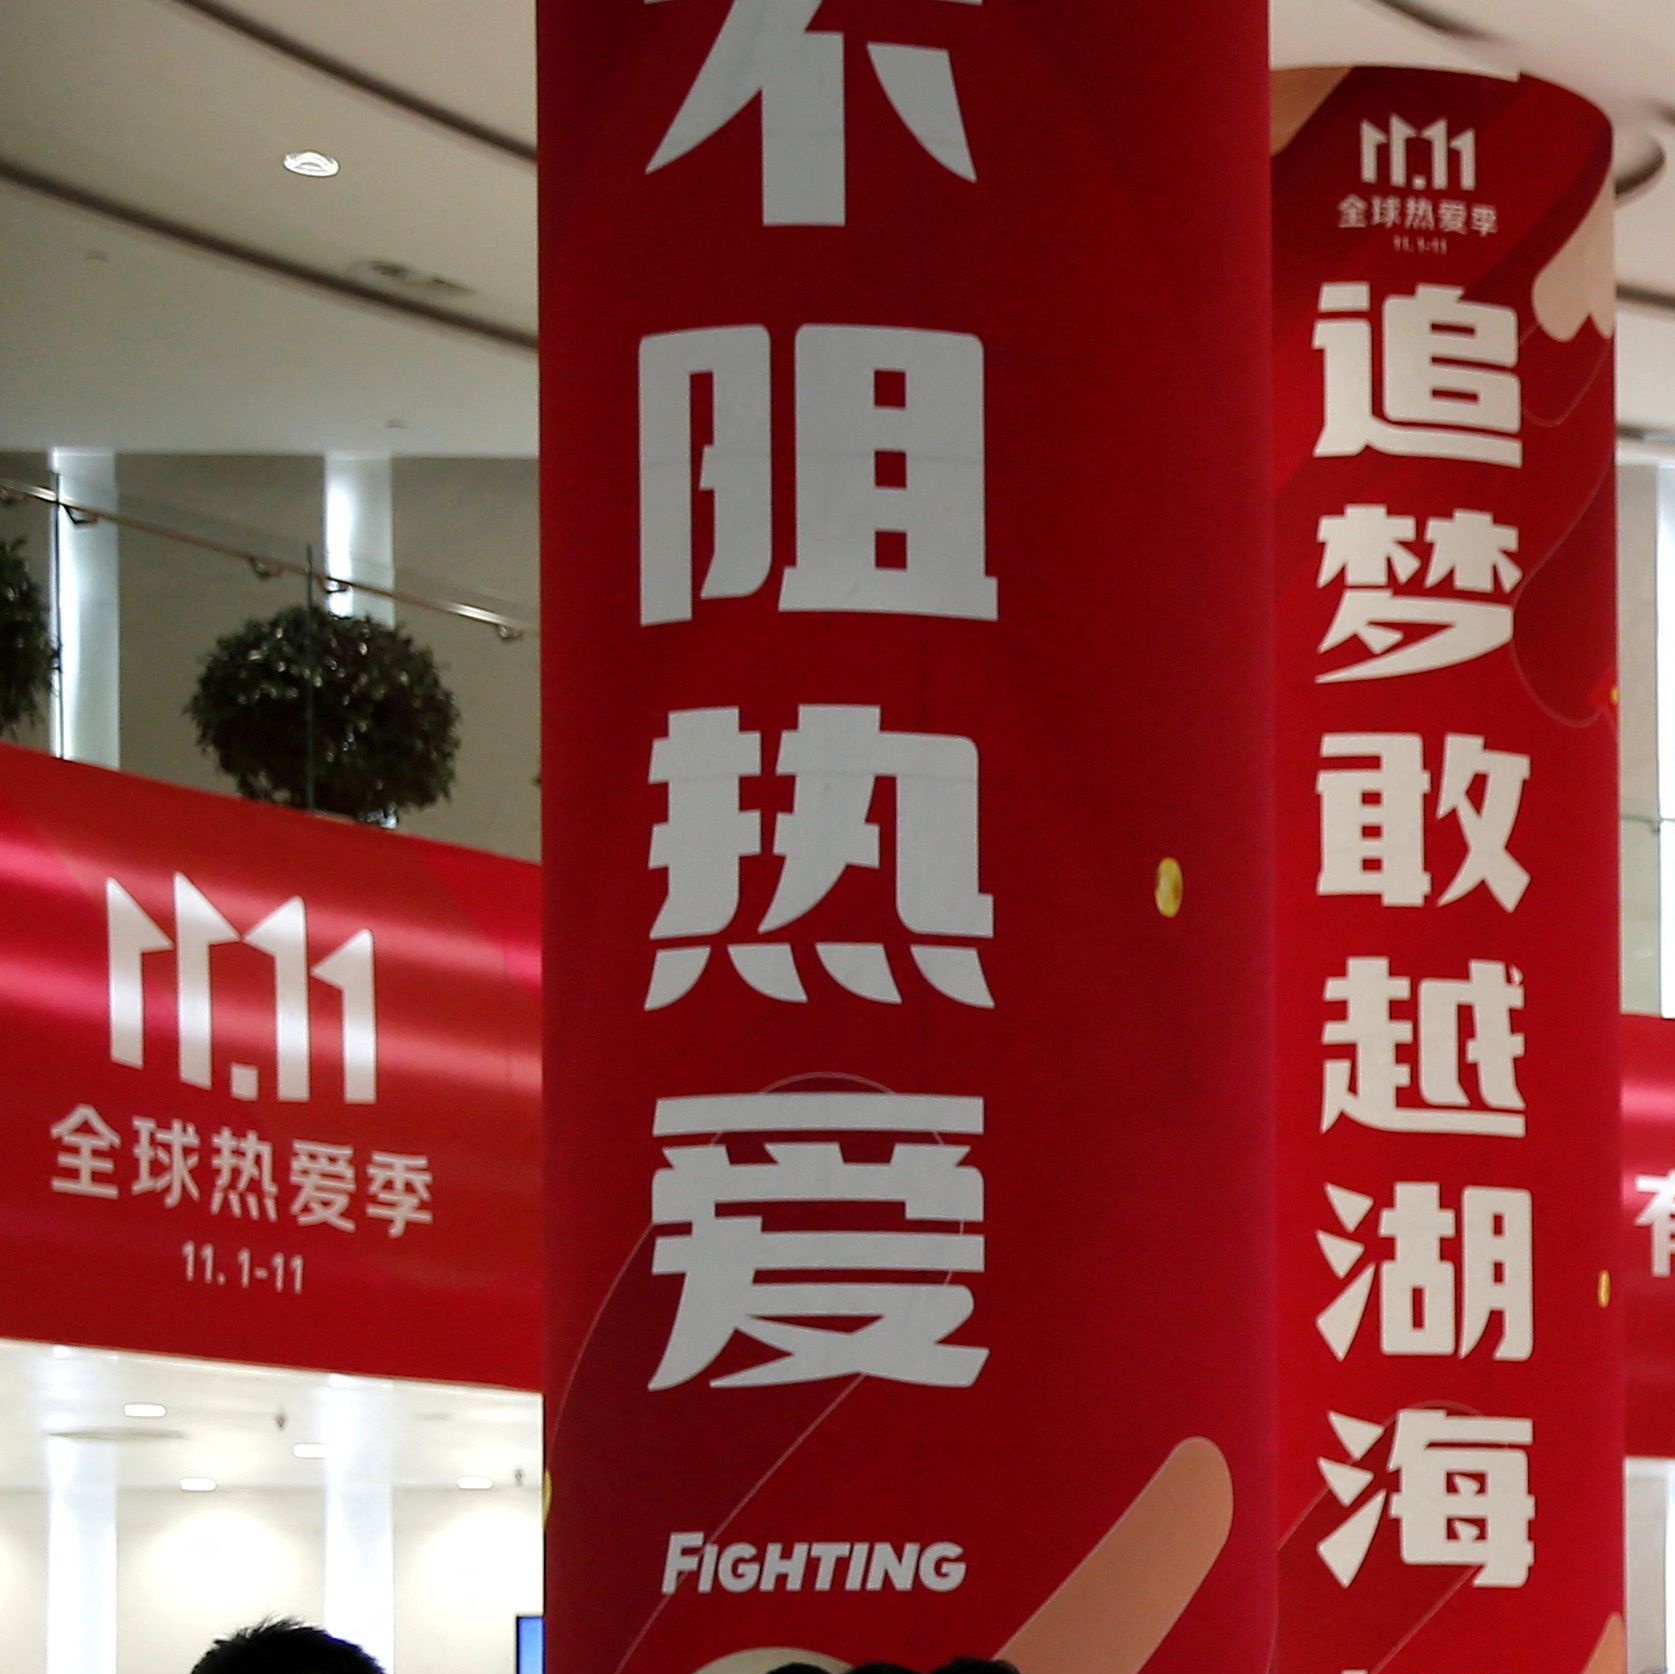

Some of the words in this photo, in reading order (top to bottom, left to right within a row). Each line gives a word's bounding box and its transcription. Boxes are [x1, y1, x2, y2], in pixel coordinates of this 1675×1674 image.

[1336, 194, 1500, 236] 全球热爱季
[639, 0, 998, 1391] 不阻热爱
[1311, 281, 1536, 1588] 追梦敢越湖海
[50, 1103, 434, 1238] 全球热爱季
